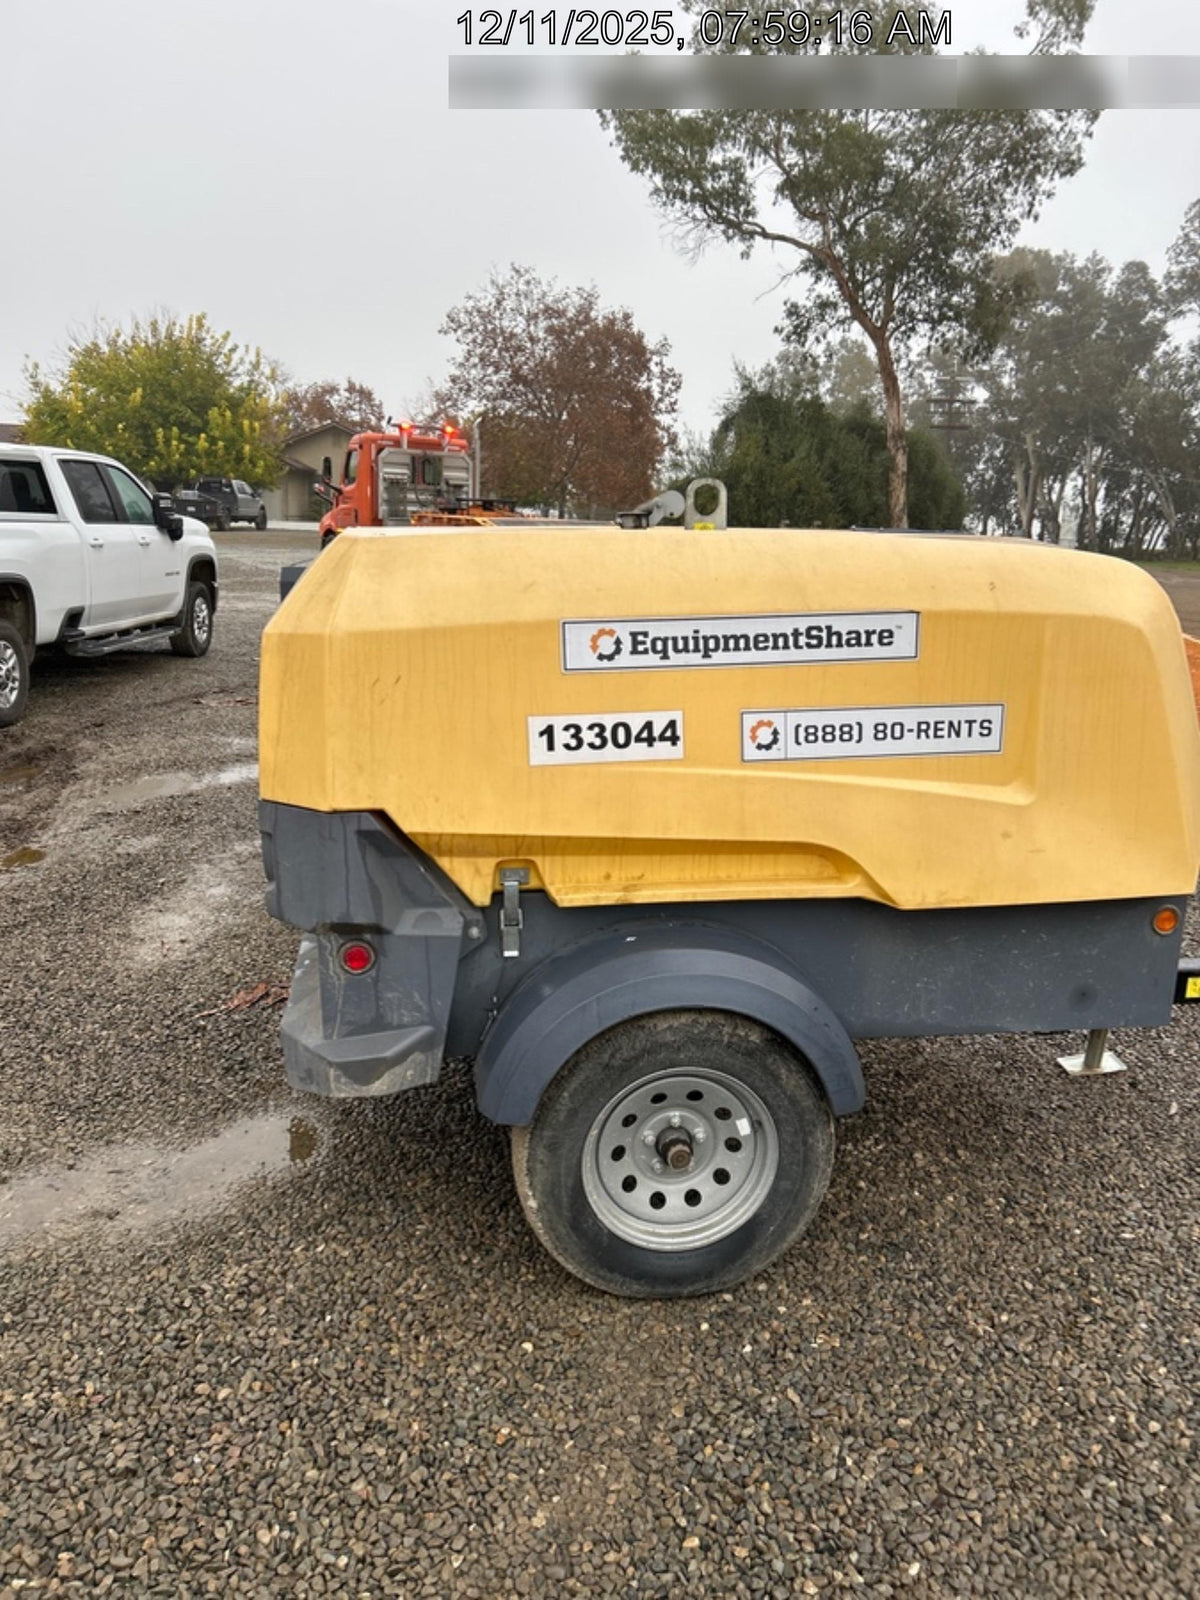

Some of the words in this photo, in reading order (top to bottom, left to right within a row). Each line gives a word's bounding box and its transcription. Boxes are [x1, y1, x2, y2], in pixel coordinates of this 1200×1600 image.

[628, 625, 895, 659] EquipmentShare
[538, 719, 681, 752] 133044
[793, 722, 863, 745] (888)
[872, 719, 994, 742] 80-RENTS
